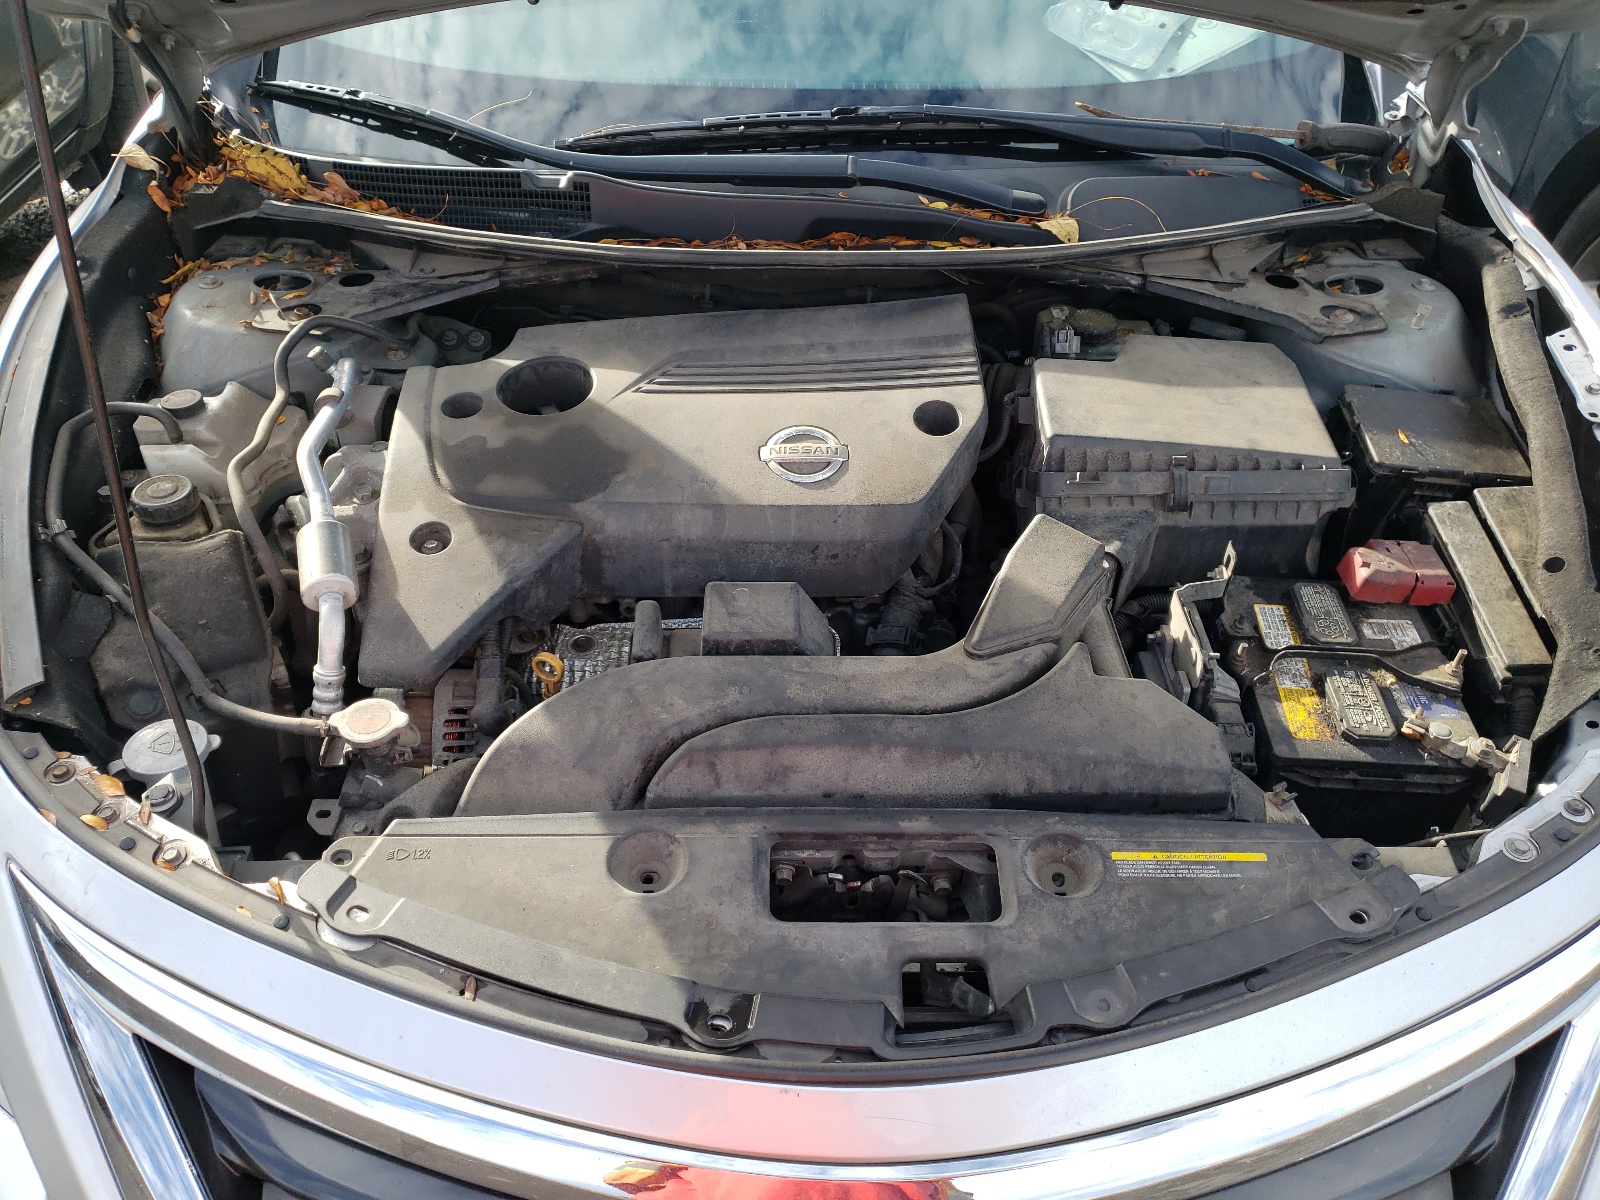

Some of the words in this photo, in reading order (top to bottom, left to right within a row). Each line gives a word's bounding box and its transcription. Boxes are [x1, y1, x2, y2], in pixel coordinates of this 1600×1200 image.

[769, 446, 839, 456] NISSAN
[1362, 678, 1378, 701] DANGER
[1373, 705, 1389, 728] POISON
